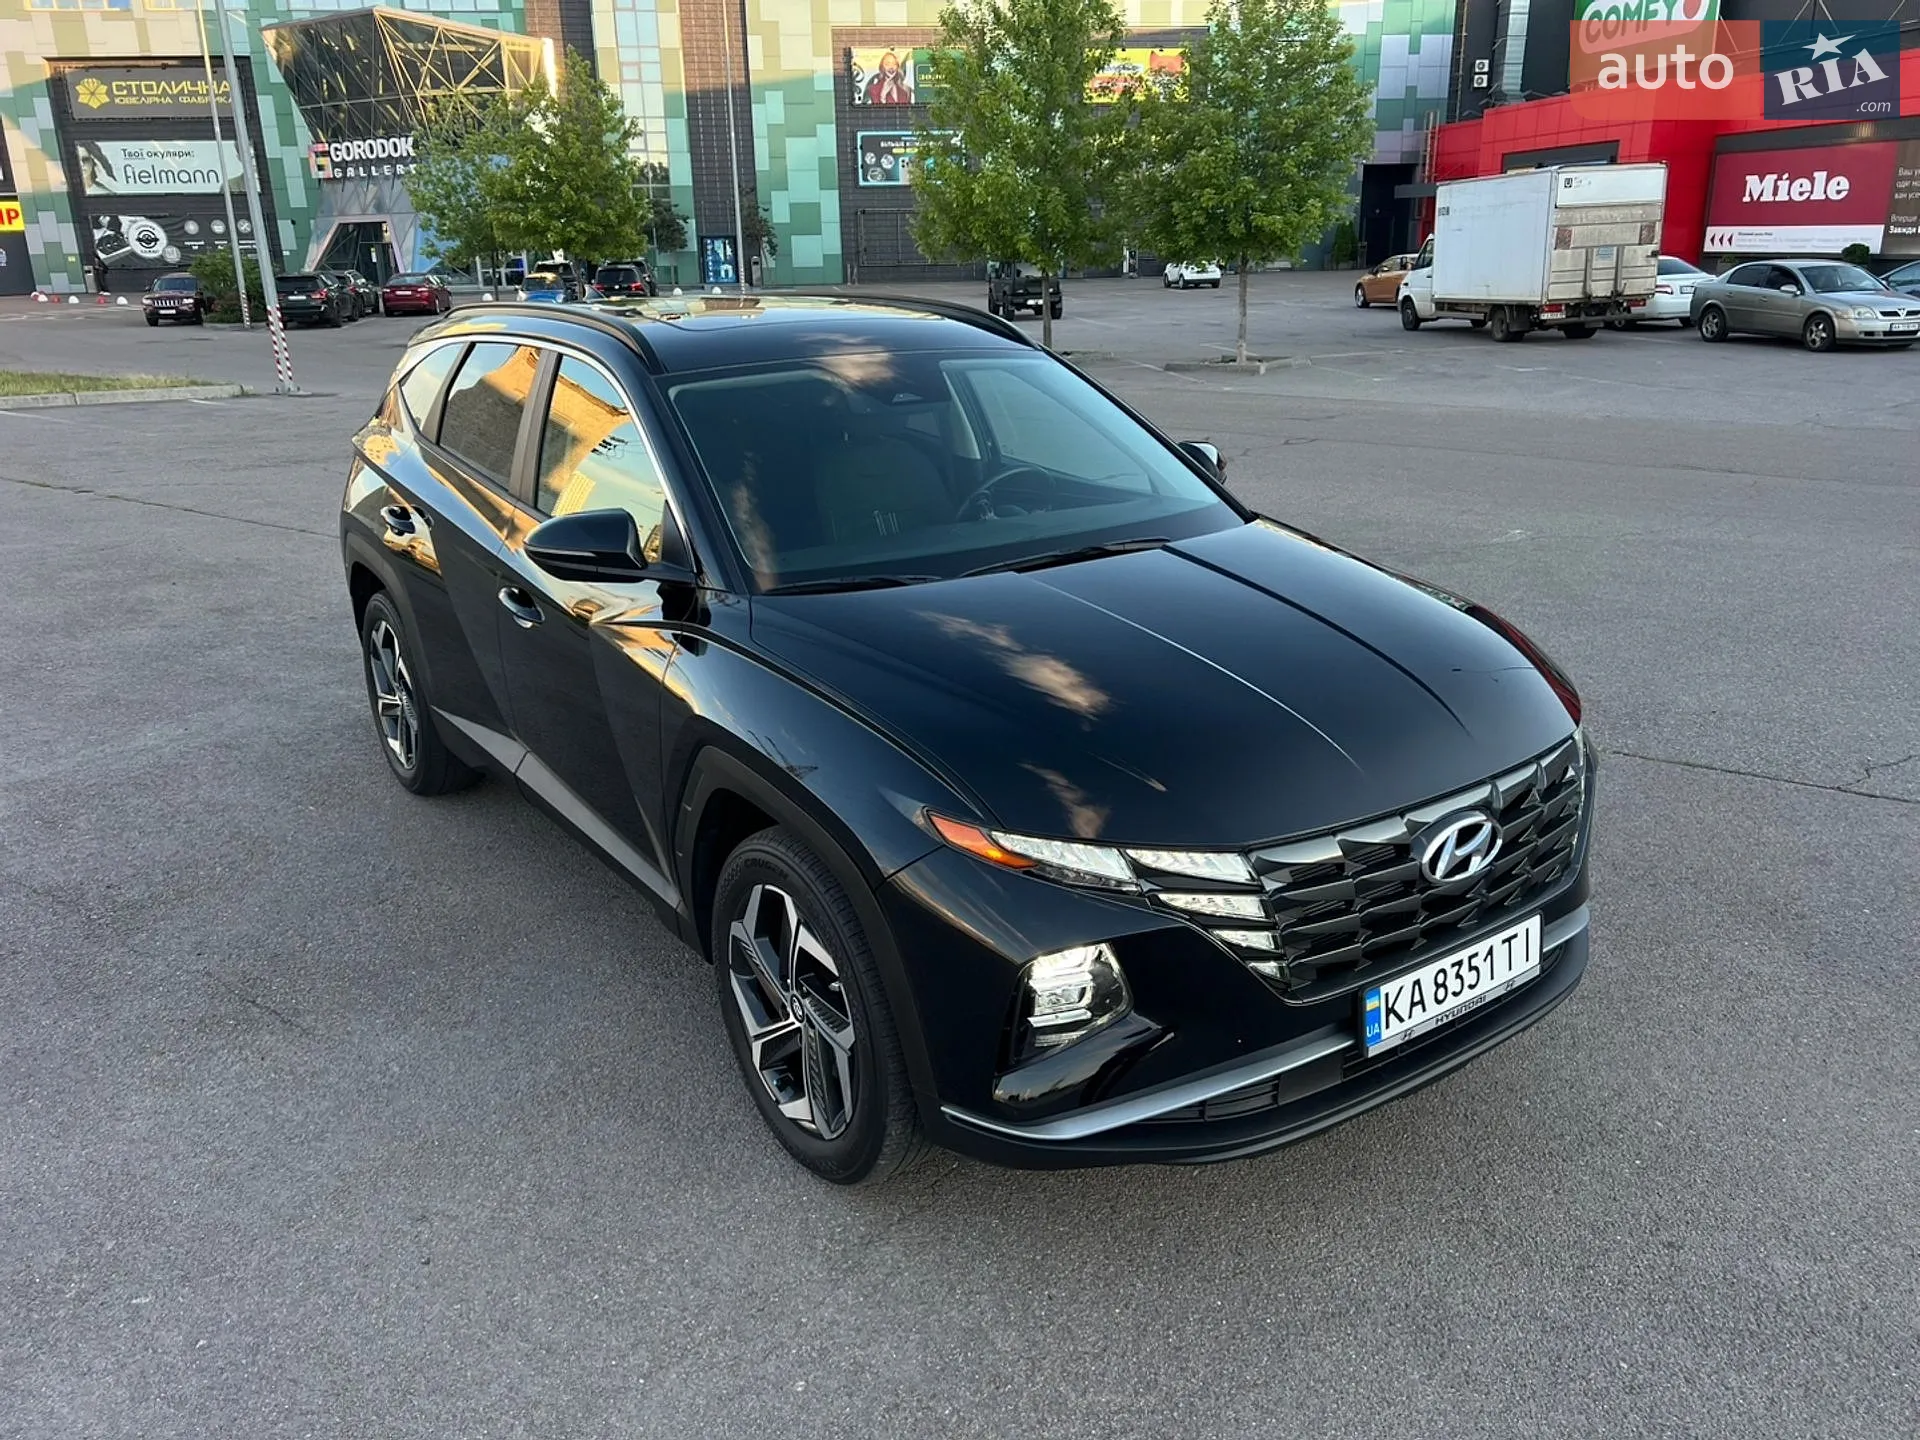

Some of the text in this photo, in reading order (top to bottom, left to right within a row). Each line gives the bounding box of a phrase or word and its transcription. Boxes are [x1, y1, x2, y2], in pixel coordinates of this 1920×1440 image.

[1585, 0, 1676, 43] COMFY
[330, 137, 416, 162] GORODOK
[1743, 171, 1850, 202] Miele
[1384, 927, 1529, 1030] KA 8351 TI
[1367, 1023, 1380, 1038] UA
